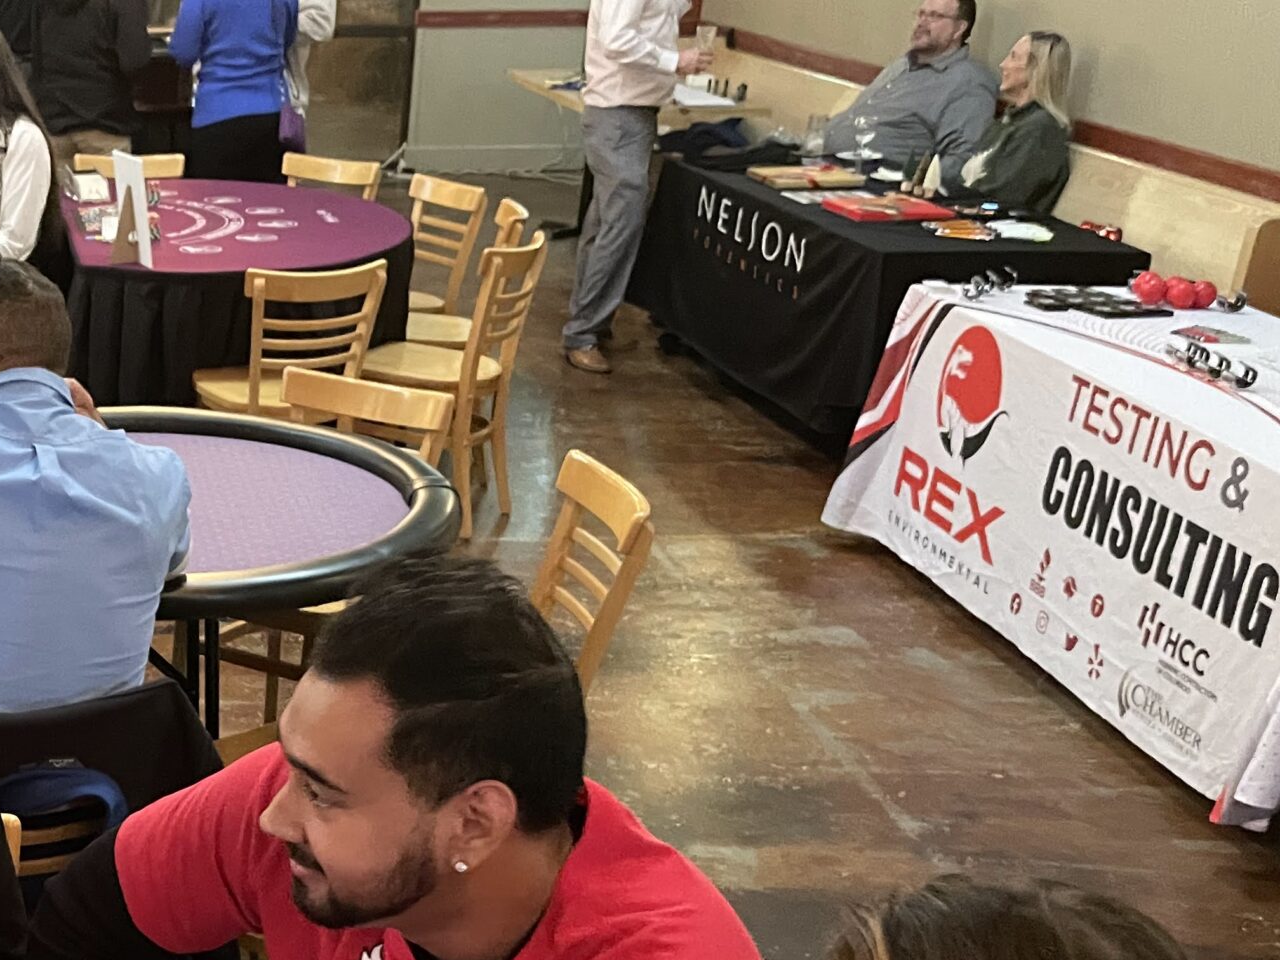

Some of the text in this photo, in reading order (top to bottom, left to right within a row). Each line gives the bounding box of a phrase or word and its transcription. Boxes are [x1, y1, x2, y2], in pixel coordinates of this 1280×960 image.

[697, 184, 807, 273] NELSON
[1068, 374, 1249, 512] TESTING &
[893, 445, 1006, 567] REX
[1042, 445, 1280, 649] CONSULTING
[888, 510, 989, 595] ENVIRONMENTAL
[1163, 627, 1210, 677] HCC
[1131, 684, 1202, 750] CHAMBER
